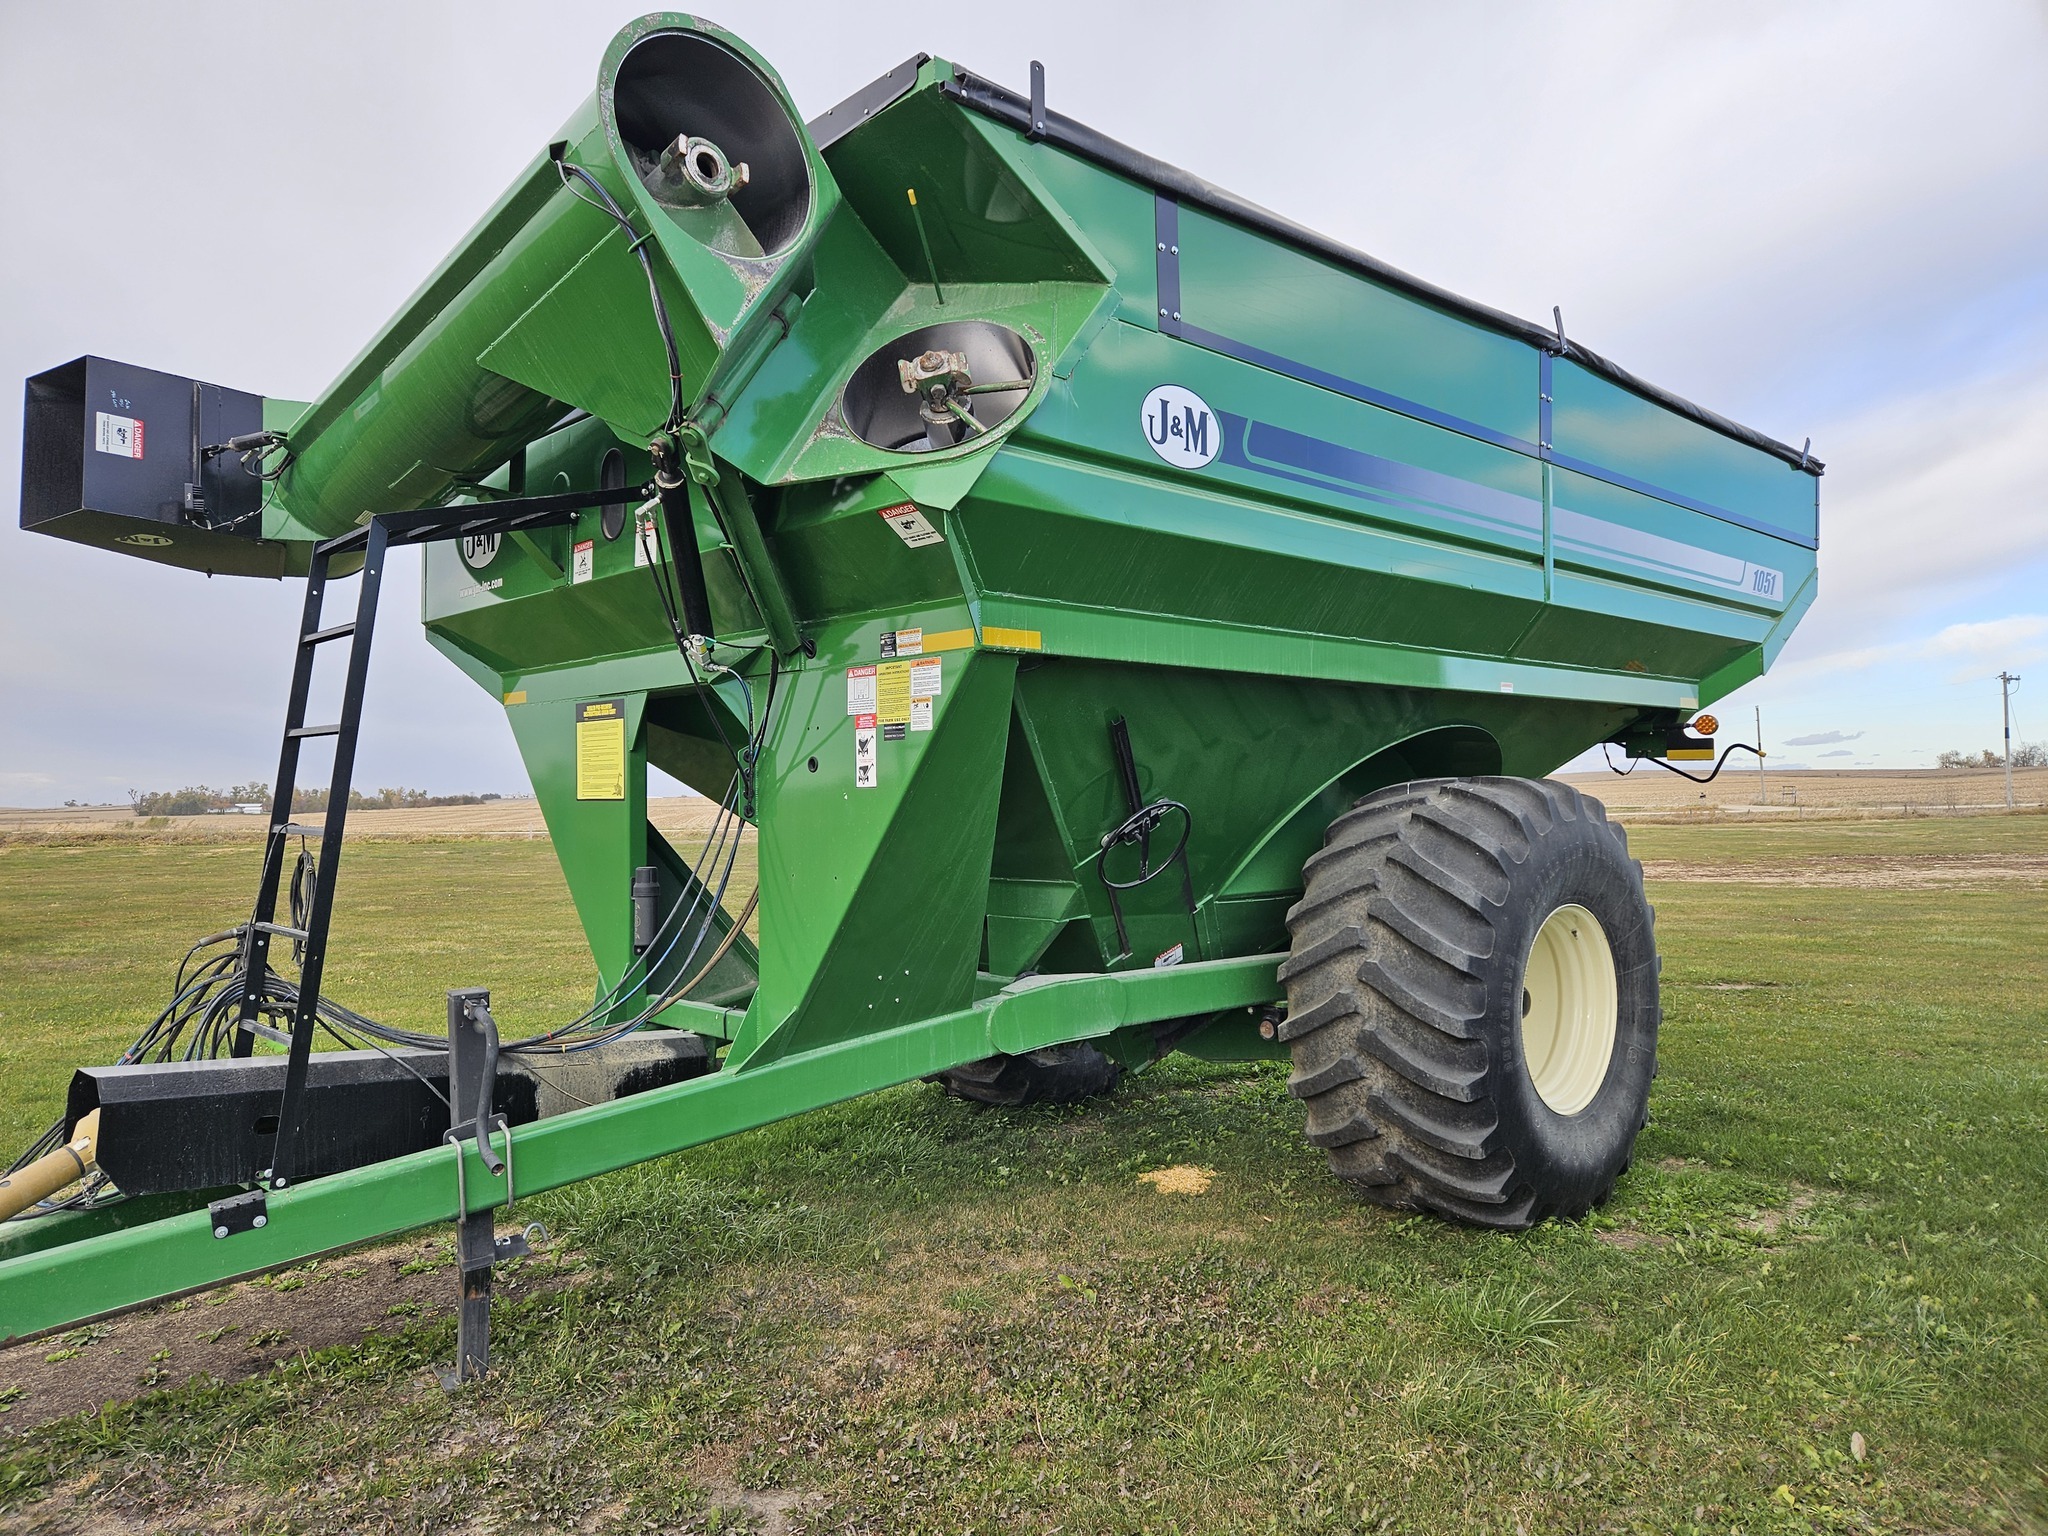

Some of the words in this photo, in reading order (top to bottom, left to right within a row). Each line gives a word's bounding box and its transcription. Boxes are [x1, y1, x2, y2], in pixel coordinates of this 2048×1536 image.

[1147, 398, 1209, 457] J&M
[134, 428, 142, 458] DANGER
[887, 504, 917, 517] DANGER
[577, 540, 593, 551] DANGER
[1752, 569, 1777, 596] 1051
[853, 667, 876, 677] DANGER
